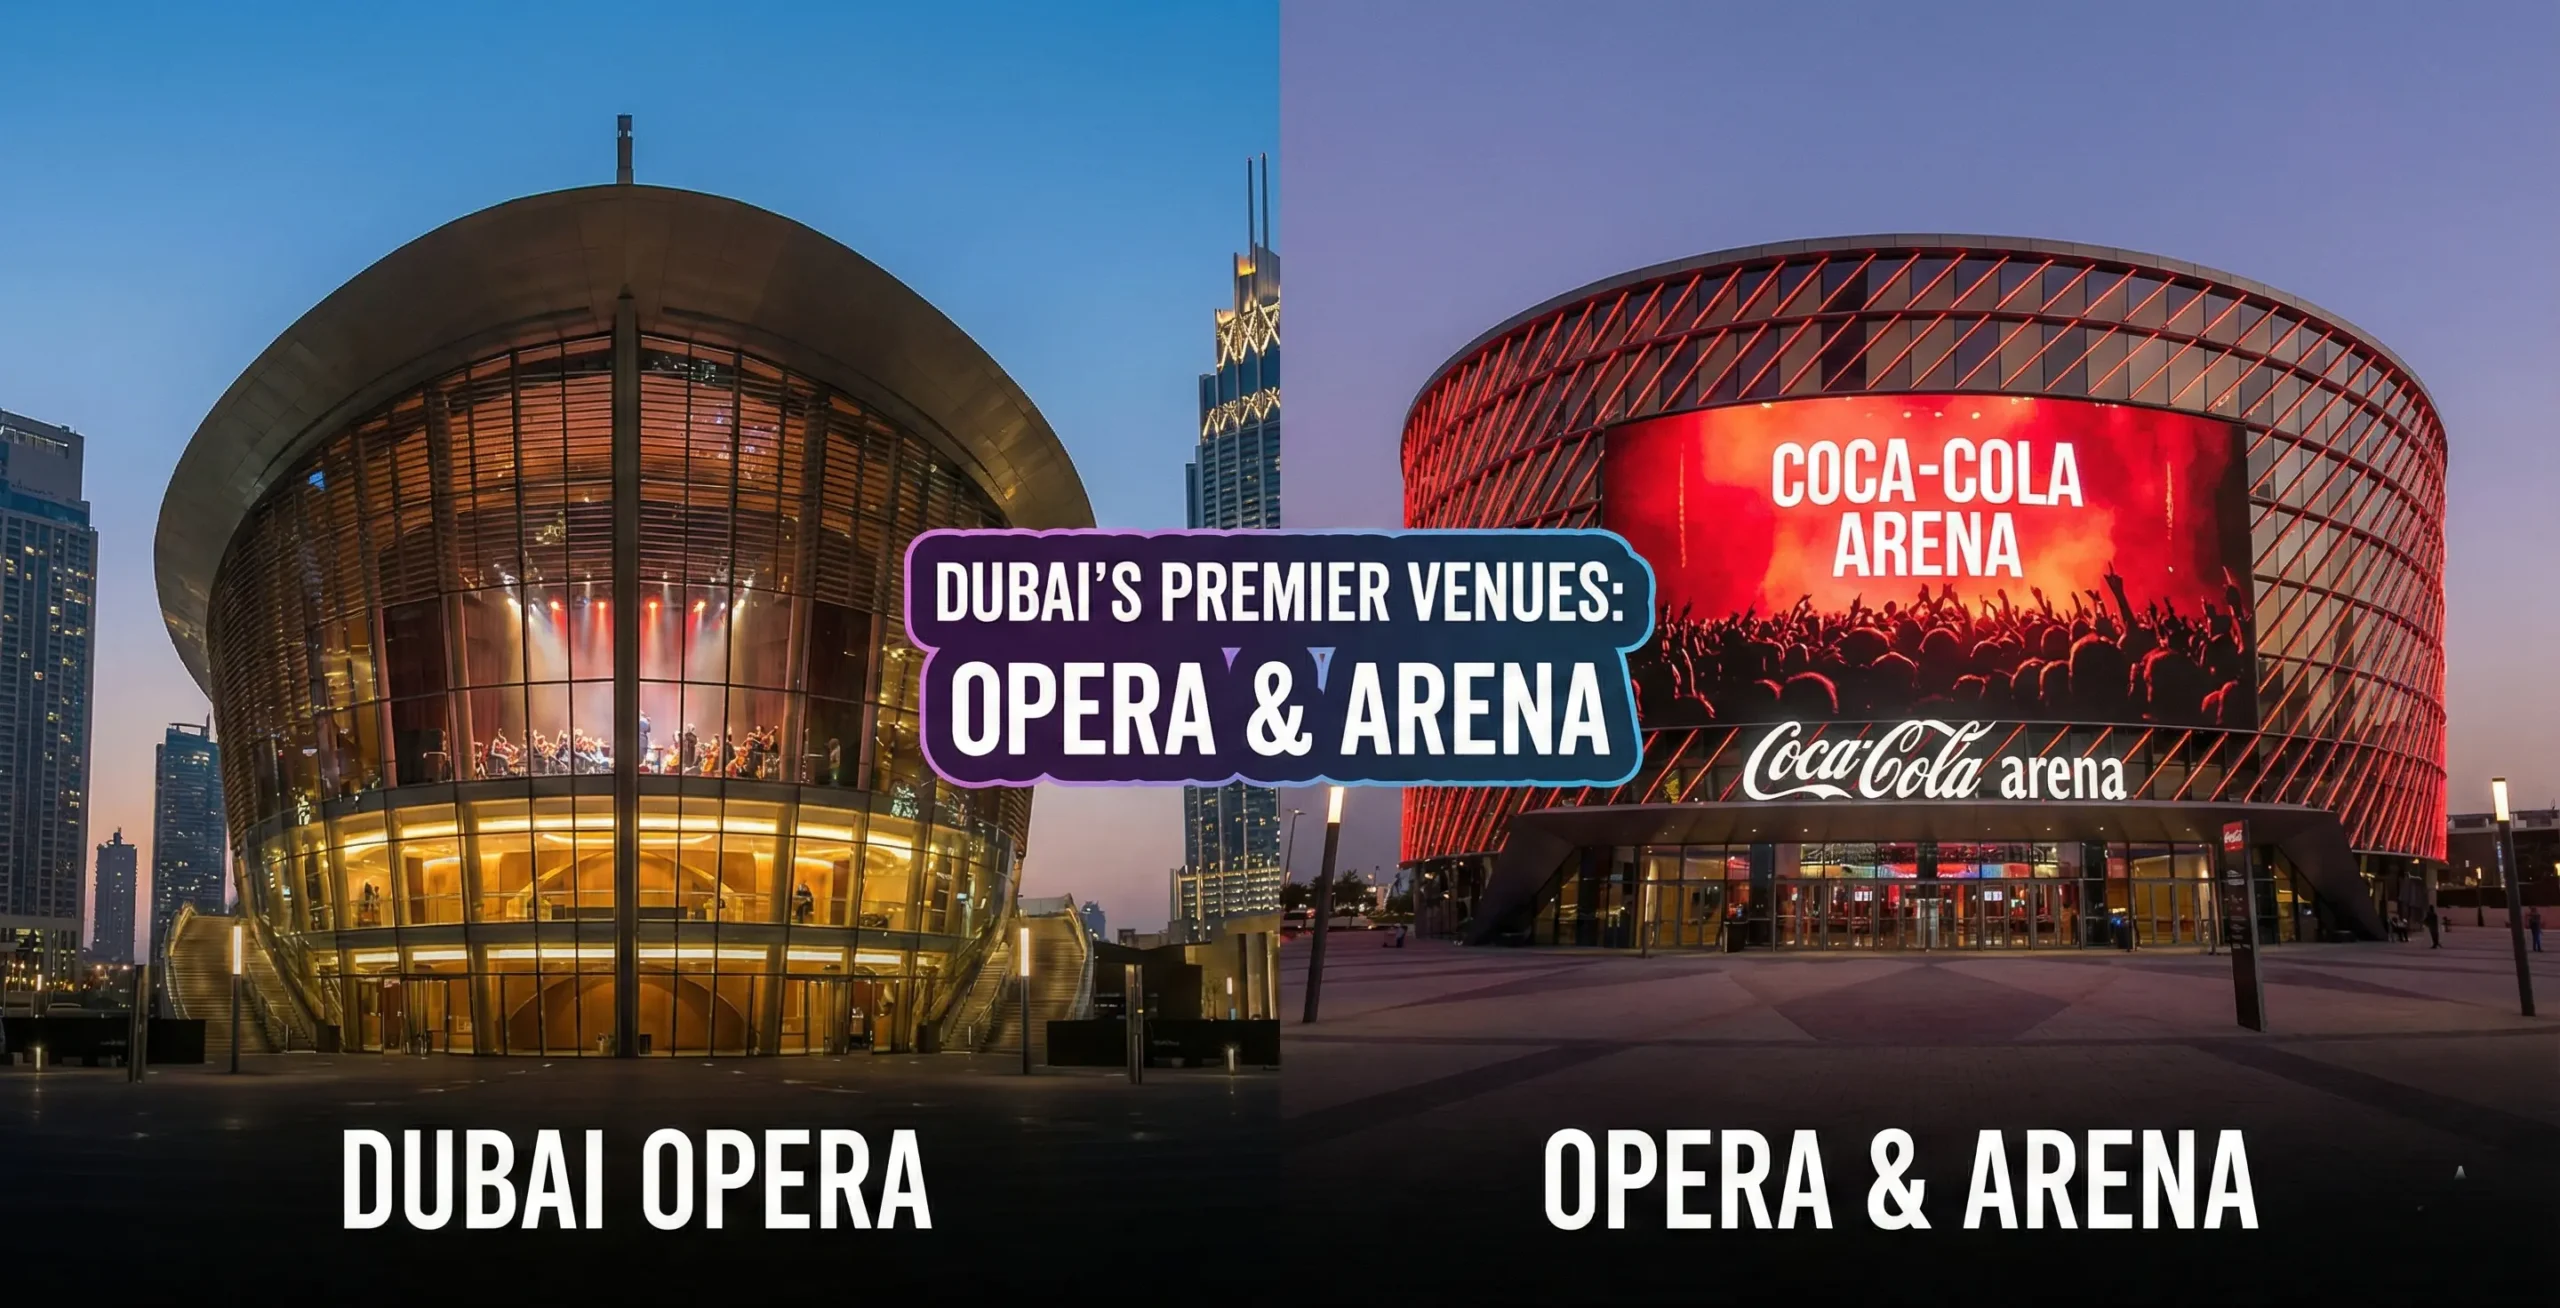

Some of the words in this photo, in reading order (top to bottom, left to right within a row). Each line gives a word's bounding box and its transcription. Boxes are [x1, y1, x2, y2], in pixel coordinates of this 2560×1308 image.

[1773, 438, 2084, 508] COCA-COLA
[1832, 511, 2023, 578] ARENA
[1742, 719, 1997, 801] Coca-Cola
[2000, 755, 2128, 801] arena
